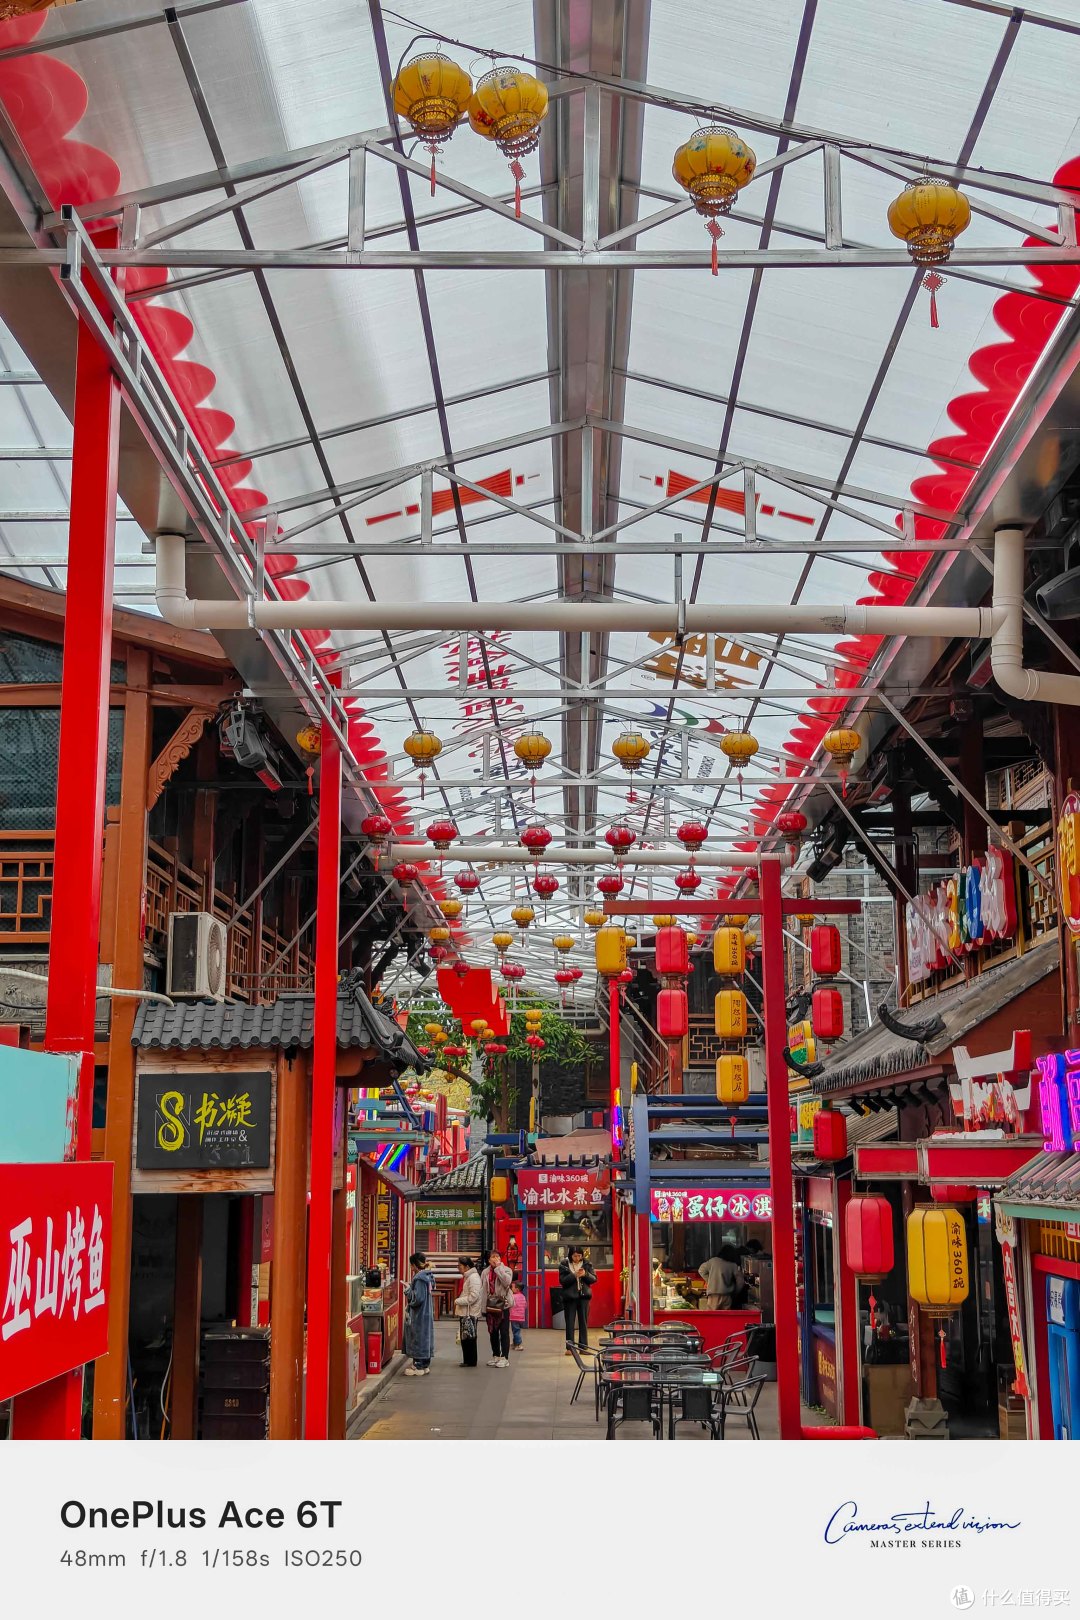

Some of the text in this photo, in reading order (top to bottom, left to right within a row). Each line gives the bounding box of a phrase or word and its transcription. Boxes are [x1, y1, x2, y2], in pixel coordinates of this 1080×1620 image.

[522, 1186, 605, 1206] 渝北水煮鱼
[549, 1173, 589, 1184] 渝味360碗
[1, 1203, 106, 1342] 巫山烤鱼
[951, 1222, 966, 1289] 渝味360碗
